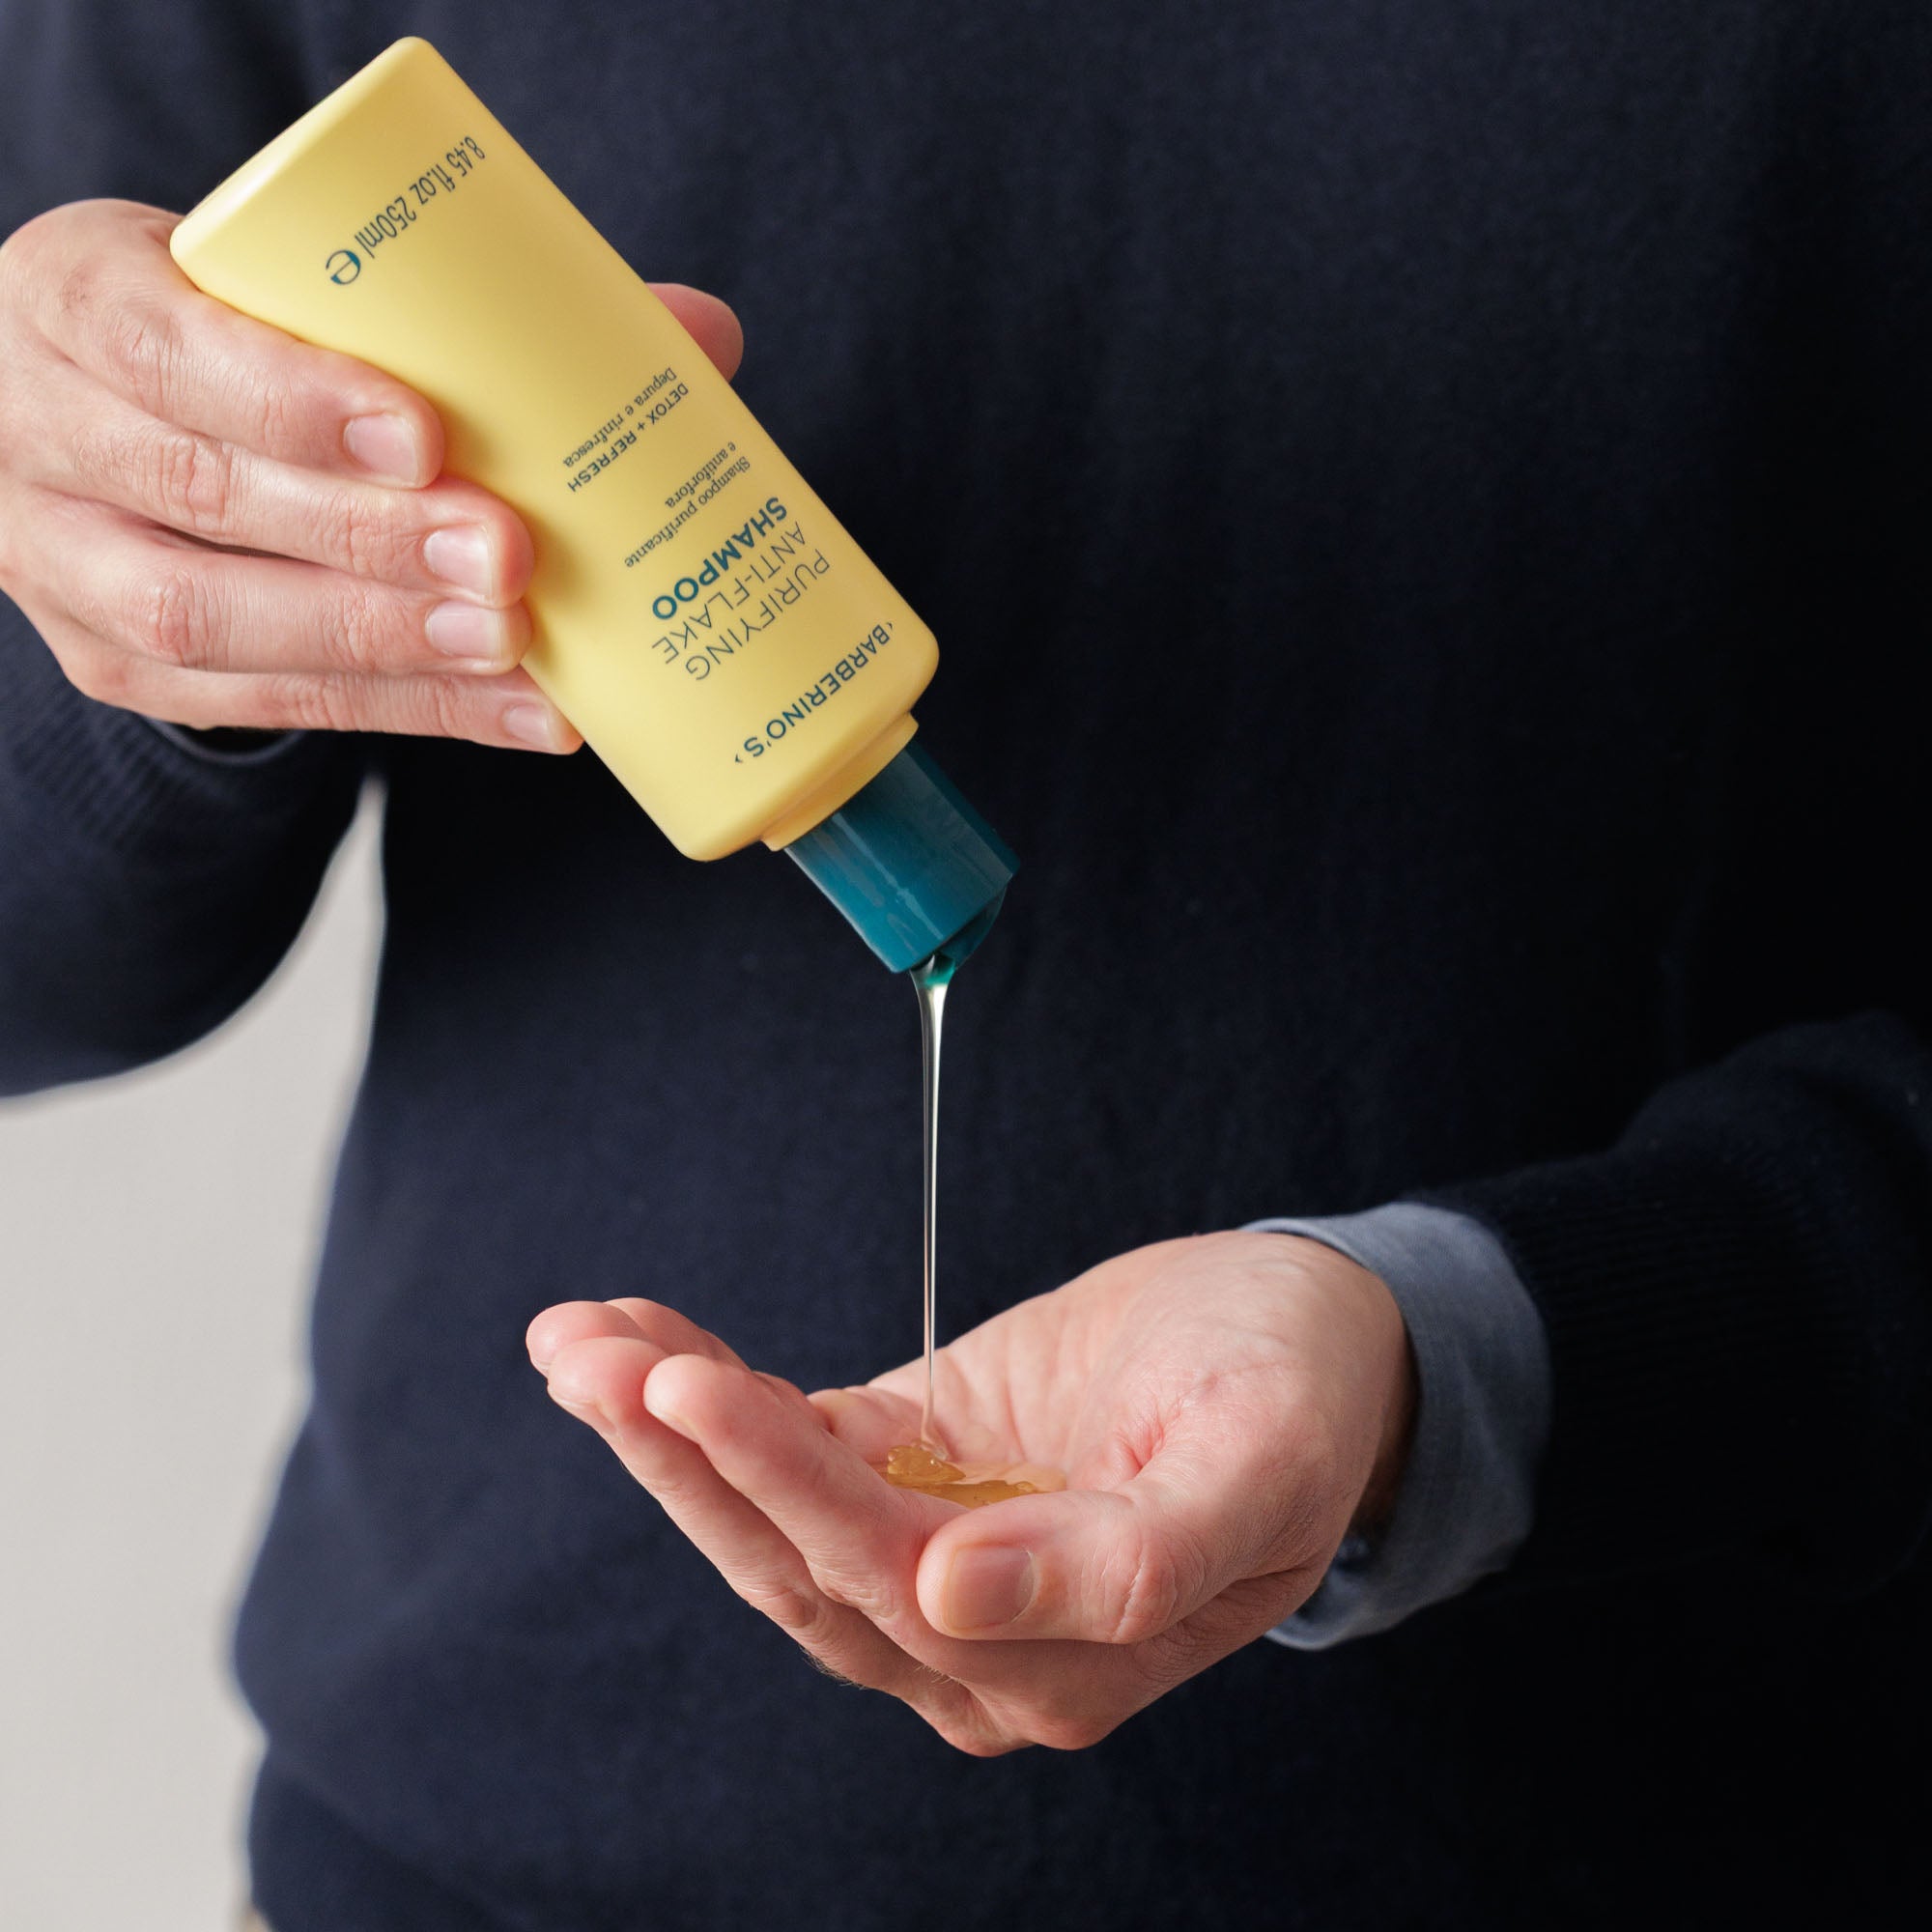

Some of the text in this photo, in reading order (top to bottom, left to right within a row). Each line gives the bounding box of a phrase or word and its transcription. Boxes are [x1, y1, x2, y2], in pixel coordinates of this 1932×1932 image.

[409, 164, 456, 205] fl.oz
[445, 135, 486, 177] 8.45
[354, 196, 417, 259] 250ml
[562, 367, 677, 468] Depura e rinfresca
[645, 383, 689, 425] DETOX
[567, 430, 638, 493] REFRESH
[665, 441, 736, 508] e antiforfora
[624, 456, 751, 567] Shampoo purificante
[652, 497, 787, 620] SHAMPOO
[652, 522, 805, 664] ANTI-FLAKE
[685, 549, 830, 680] PURIFYING
